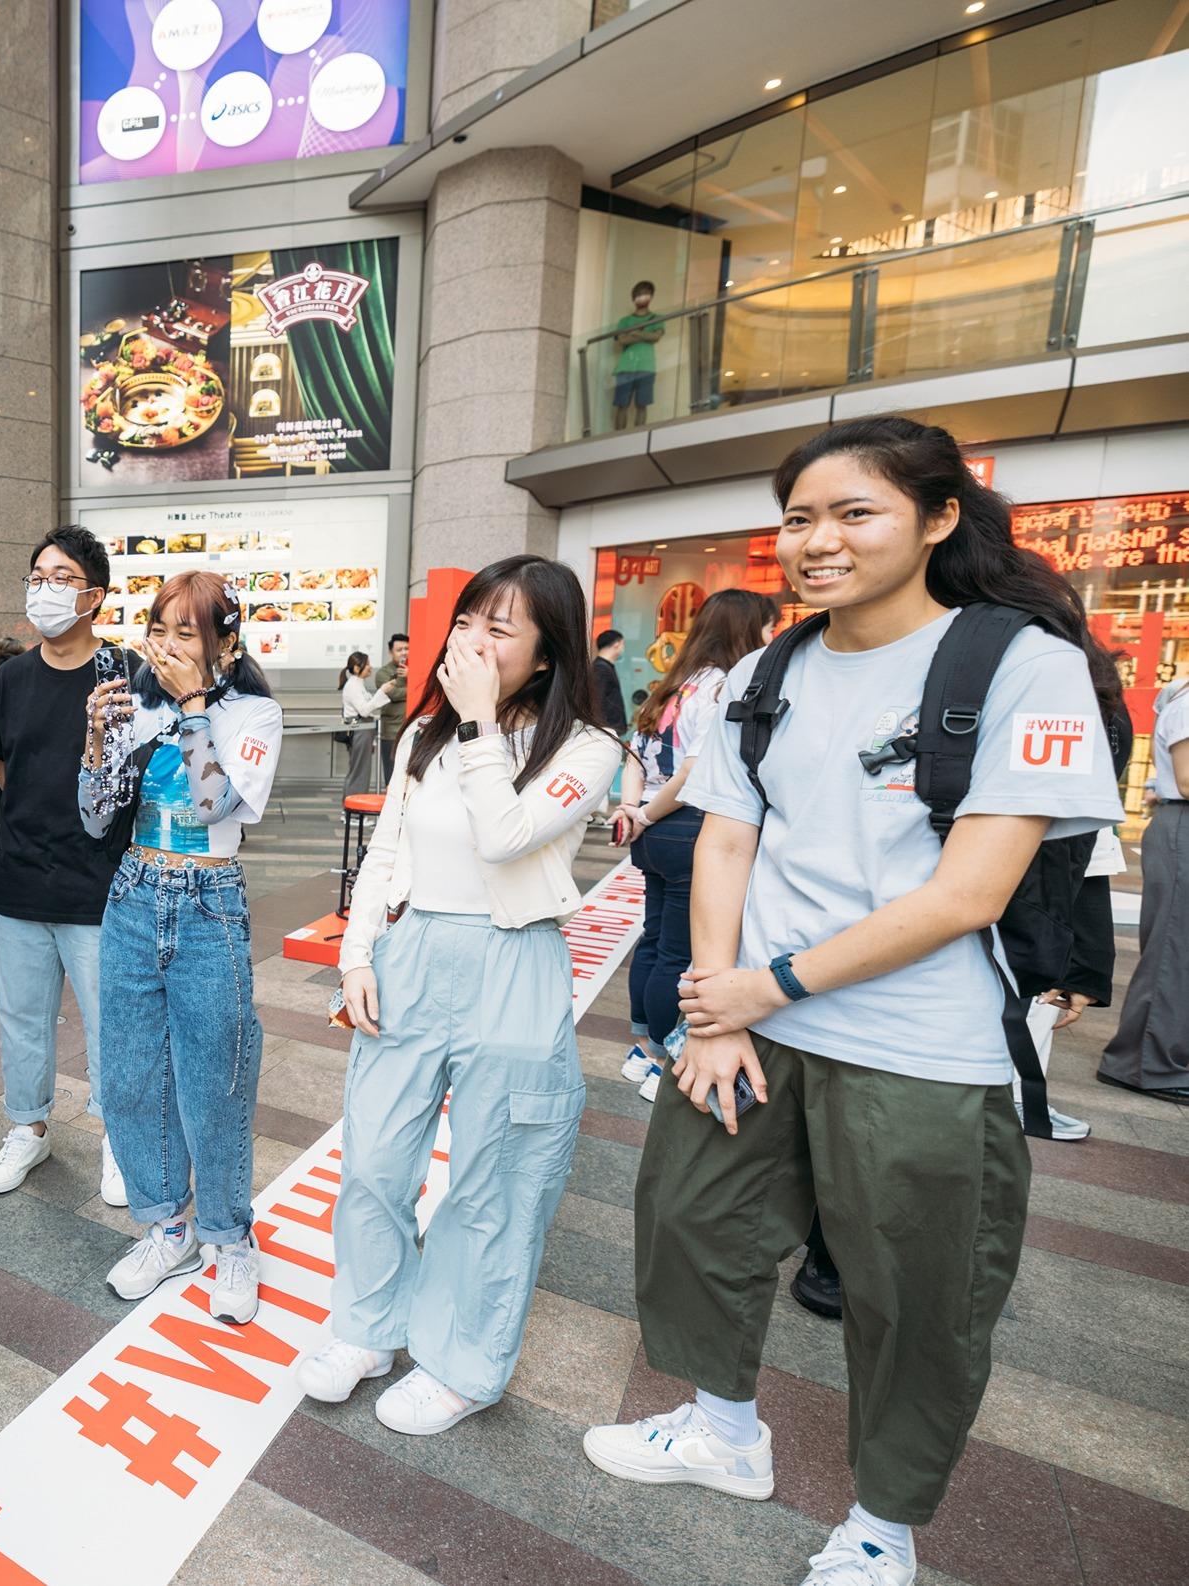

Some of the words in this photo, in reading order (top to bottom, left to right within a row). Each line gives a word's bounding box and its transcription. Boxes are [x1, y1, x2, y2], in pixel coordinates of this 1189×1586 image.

[1103, 549, 1145, 569] are
[1025, 719, 1084, 733] #WITH
[240, 742, 266, 766] UT
[1023, 733, 1083, 767] UT
[546, 777, 581, 808] UT
[558, 771, 588, 797] #WITH
